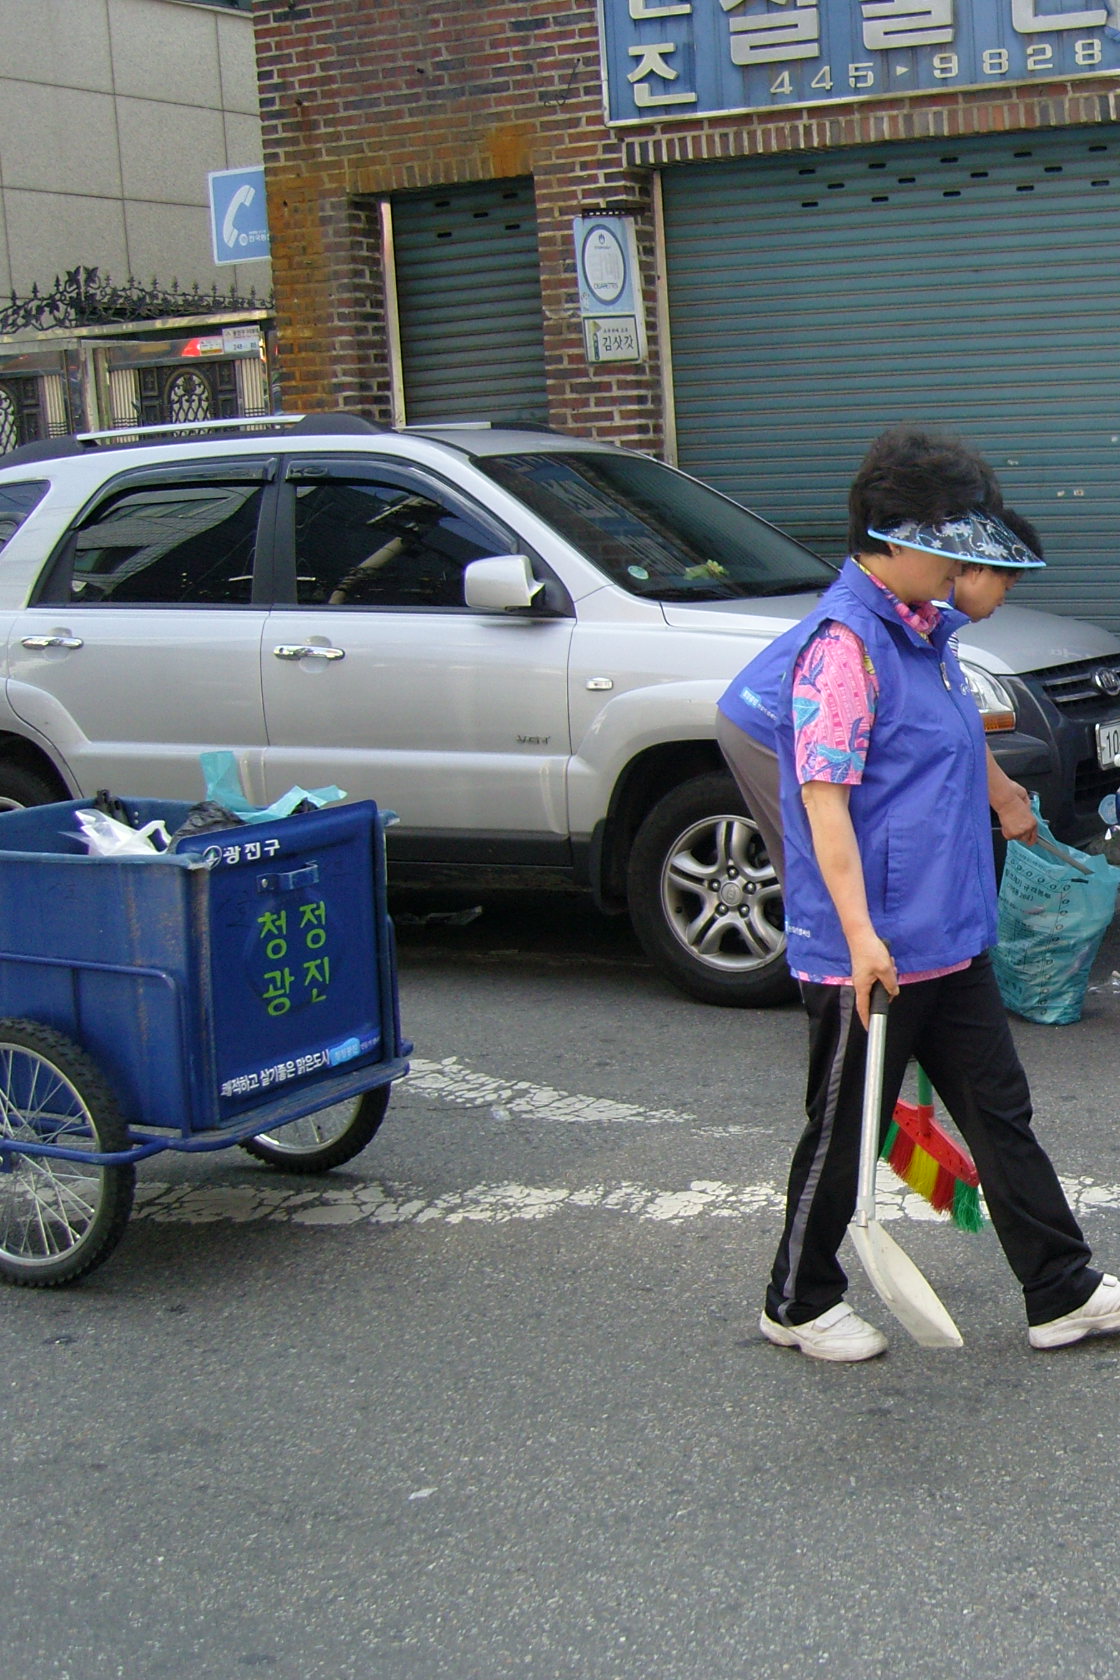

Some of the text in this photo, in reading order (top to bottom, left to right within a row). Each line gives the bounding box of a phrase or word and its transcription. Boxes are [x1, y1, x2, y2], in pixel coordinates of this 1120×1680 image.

[602, 335, 634, 351] 김삿갓
[223, 839, 280, 865] 광진구
[260, 1060, 297, 1087] 살기좋은
[296, 1048, 331, 1074] 맑은도시
